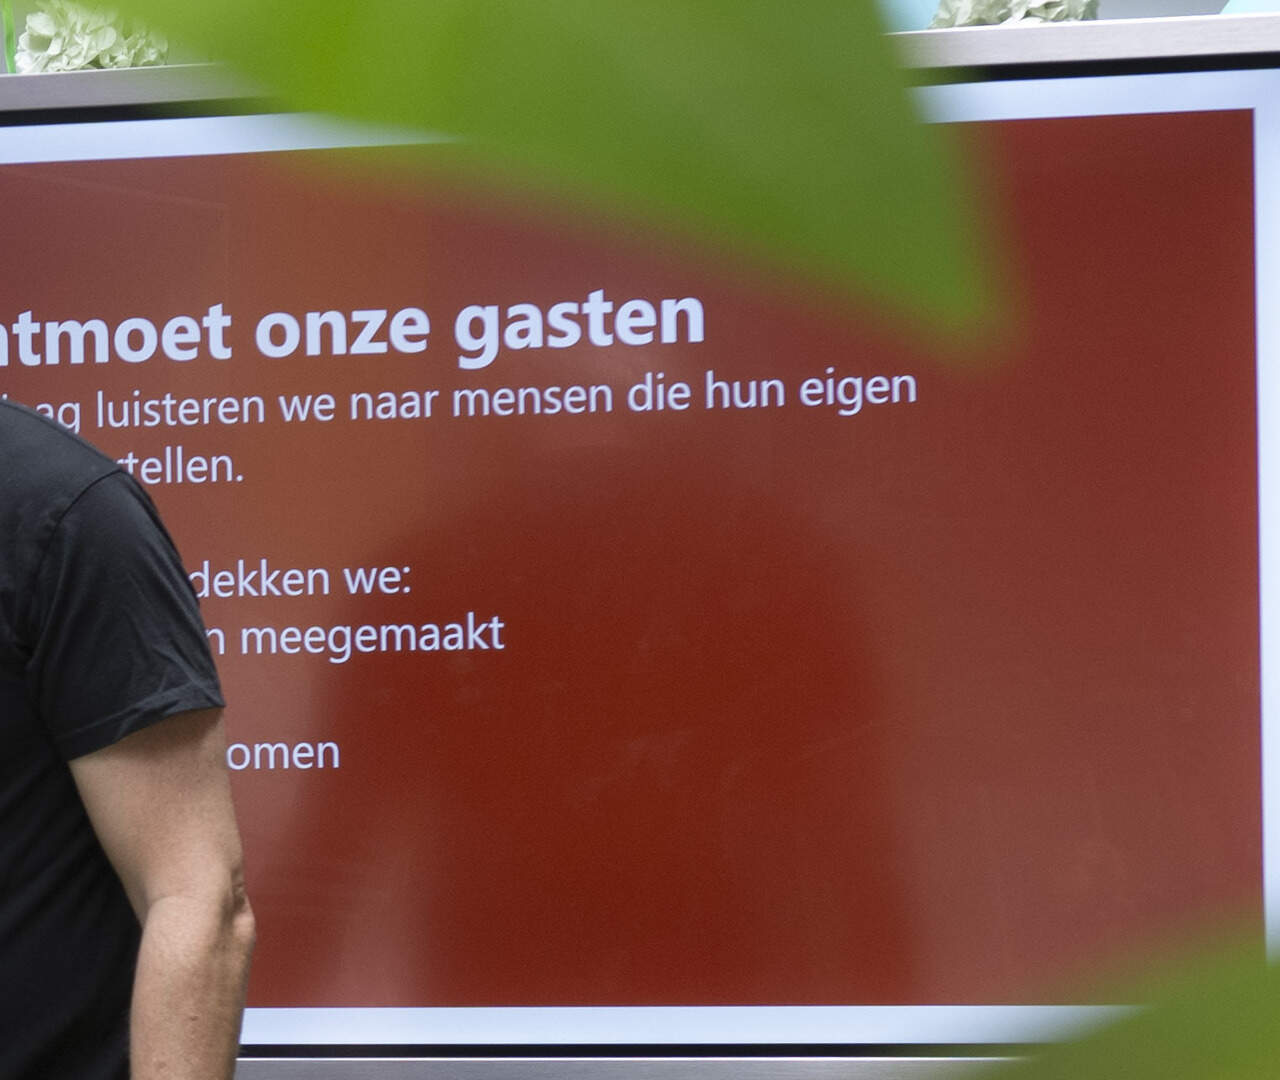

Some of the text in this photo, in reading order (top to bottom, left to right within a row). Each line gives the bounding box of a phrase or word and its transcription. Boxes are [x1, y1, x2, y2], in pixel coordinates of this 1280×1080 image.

[256, 304, 431, 358] onze
[454, 288, 705, 369] gasten
[96, 389, 266, 428] luisteren
[279, 392, 336, 422] we
[349, 389, 440, 421] naar
[452, 381, 613, 417] mensen
[627, 371, 691, 412] die
[704, 369, 786, 410] hun
[799, 365, 918, 417] eigen
[116, 445, 244, 485] tellen.
[187, 558, 412, 598] dekken we:
[241, 611, 506, 665] meegemaakt
[226, 740, 340, 771] omen
